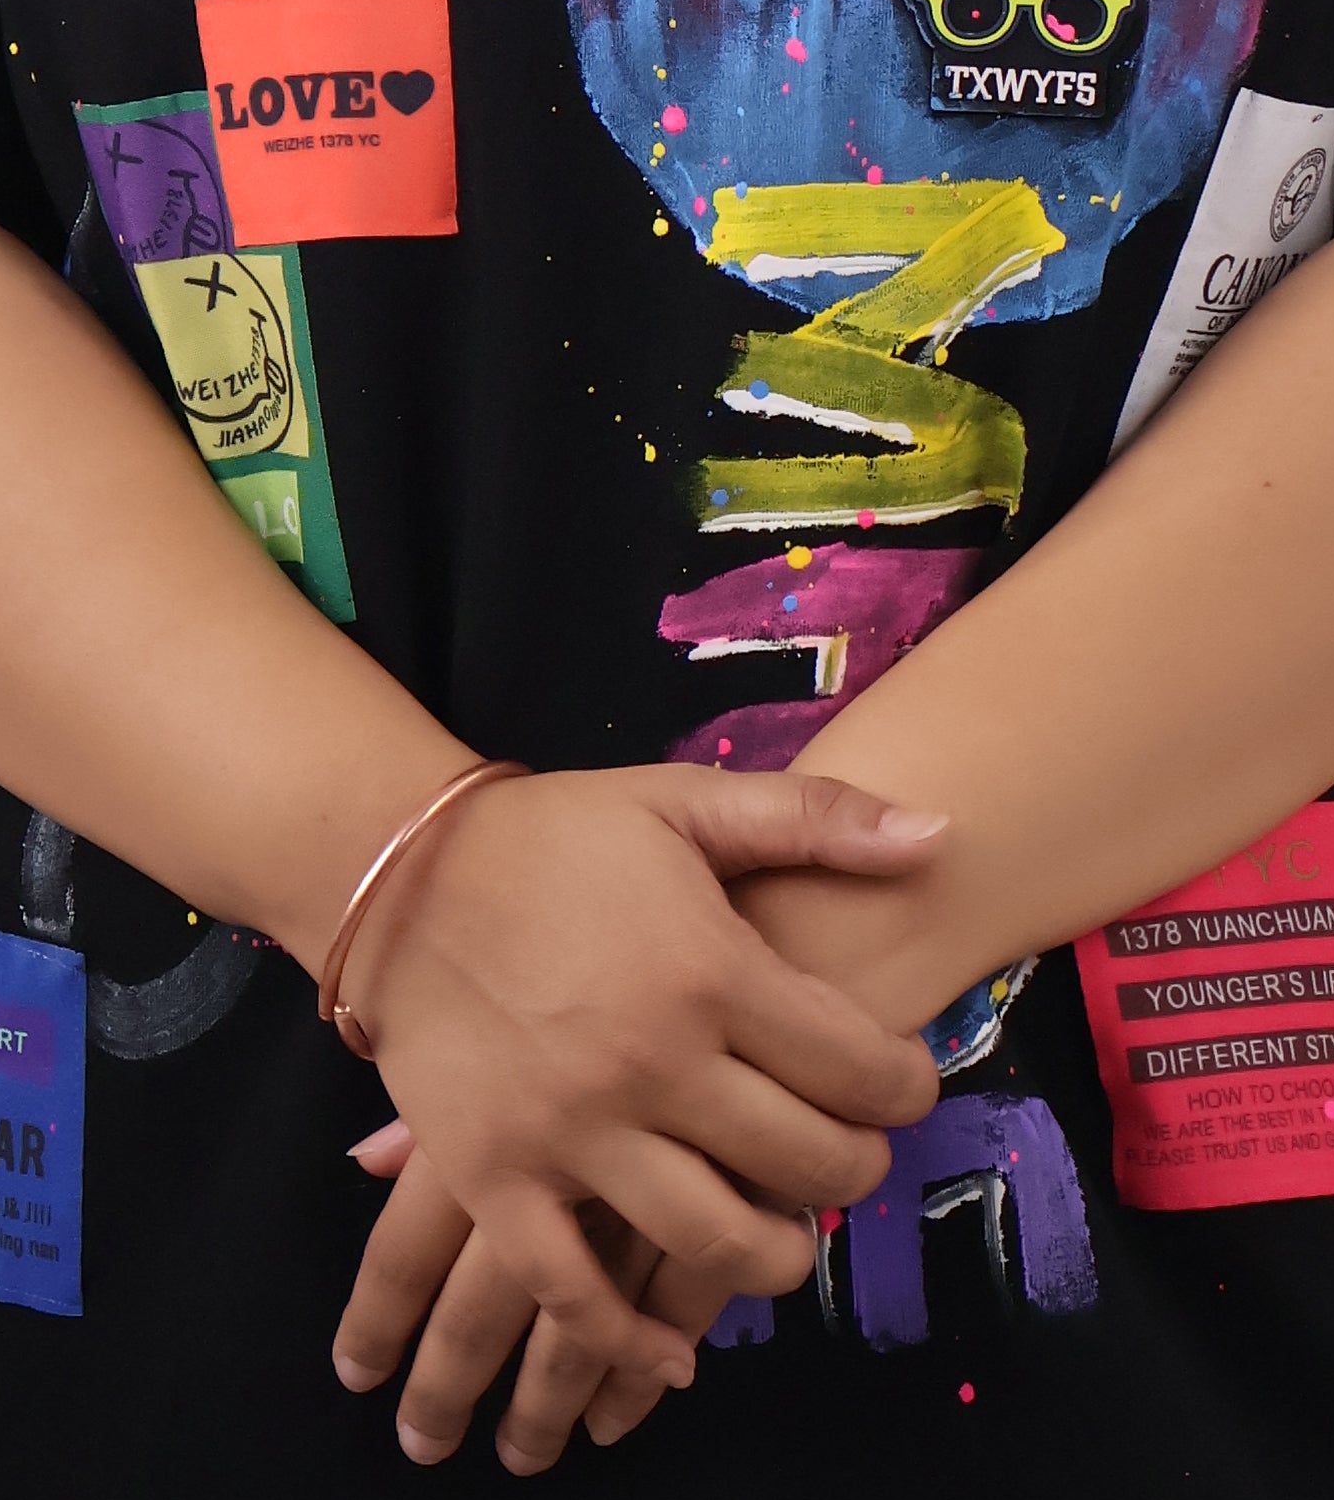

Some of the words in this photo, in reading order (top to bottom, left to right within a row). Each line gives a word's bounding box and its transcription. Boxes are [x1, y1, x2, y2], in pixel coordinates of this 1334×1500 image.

[214, 71, 376, 130] LOVE
[945, 65, 1097, 106] TXWYFS
[263, 136, 314, 153] WEIZHE
[320, 134, 353, 149] 1378
[359, 134, 380, 148] YC
[1120, 920, 1182, 952] 1378
[1145, 971, 1305, 1012] YOUNGER'S
[1147, 1036, 1298, 1077] DIFFERENT
[1187, 1086, 1242, 1111] HOW
[1250, 1084, 1275, 1104] TO
[1142, 1123, 1171, 1143] WE
[1178, 1119, 1215, 1140] ARE
[1220, 1113, 1252, 1133] THE
[1258, 1108, 1295, 1129] BEST
[1124, 1143, 1196, 1168] PLEASE
[1202, 1137, 1260, 1162] TRUST
[1266, 1134, 1287, 1154] US
[1291, 1132, 1321, 1151] AND
